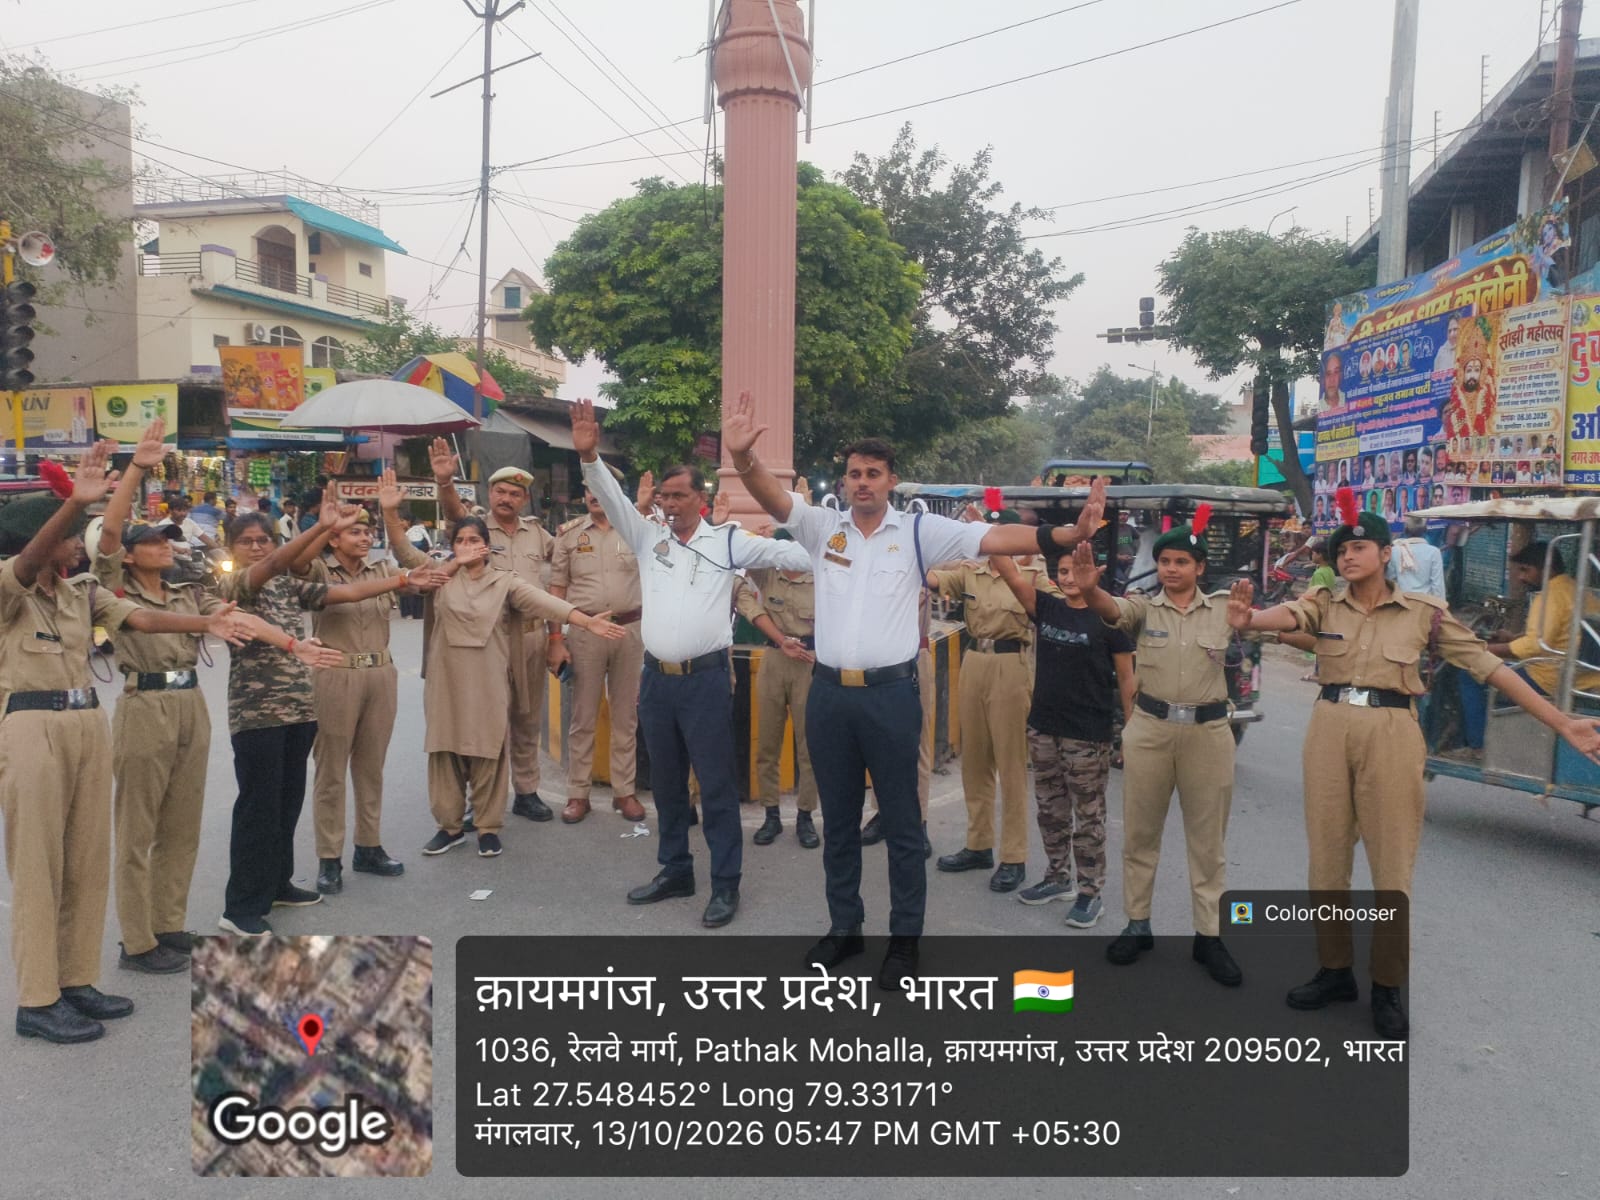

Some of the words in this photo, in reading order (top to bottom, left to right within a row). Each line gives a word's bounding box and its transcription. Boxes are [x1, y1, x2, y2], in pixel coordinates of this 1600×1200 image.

[1455, 260, 1528, 314] कॉलोनी
[1499, 323, 1524, 352] सांझी
[1527, 320, 1565, 342] महोत्सव
